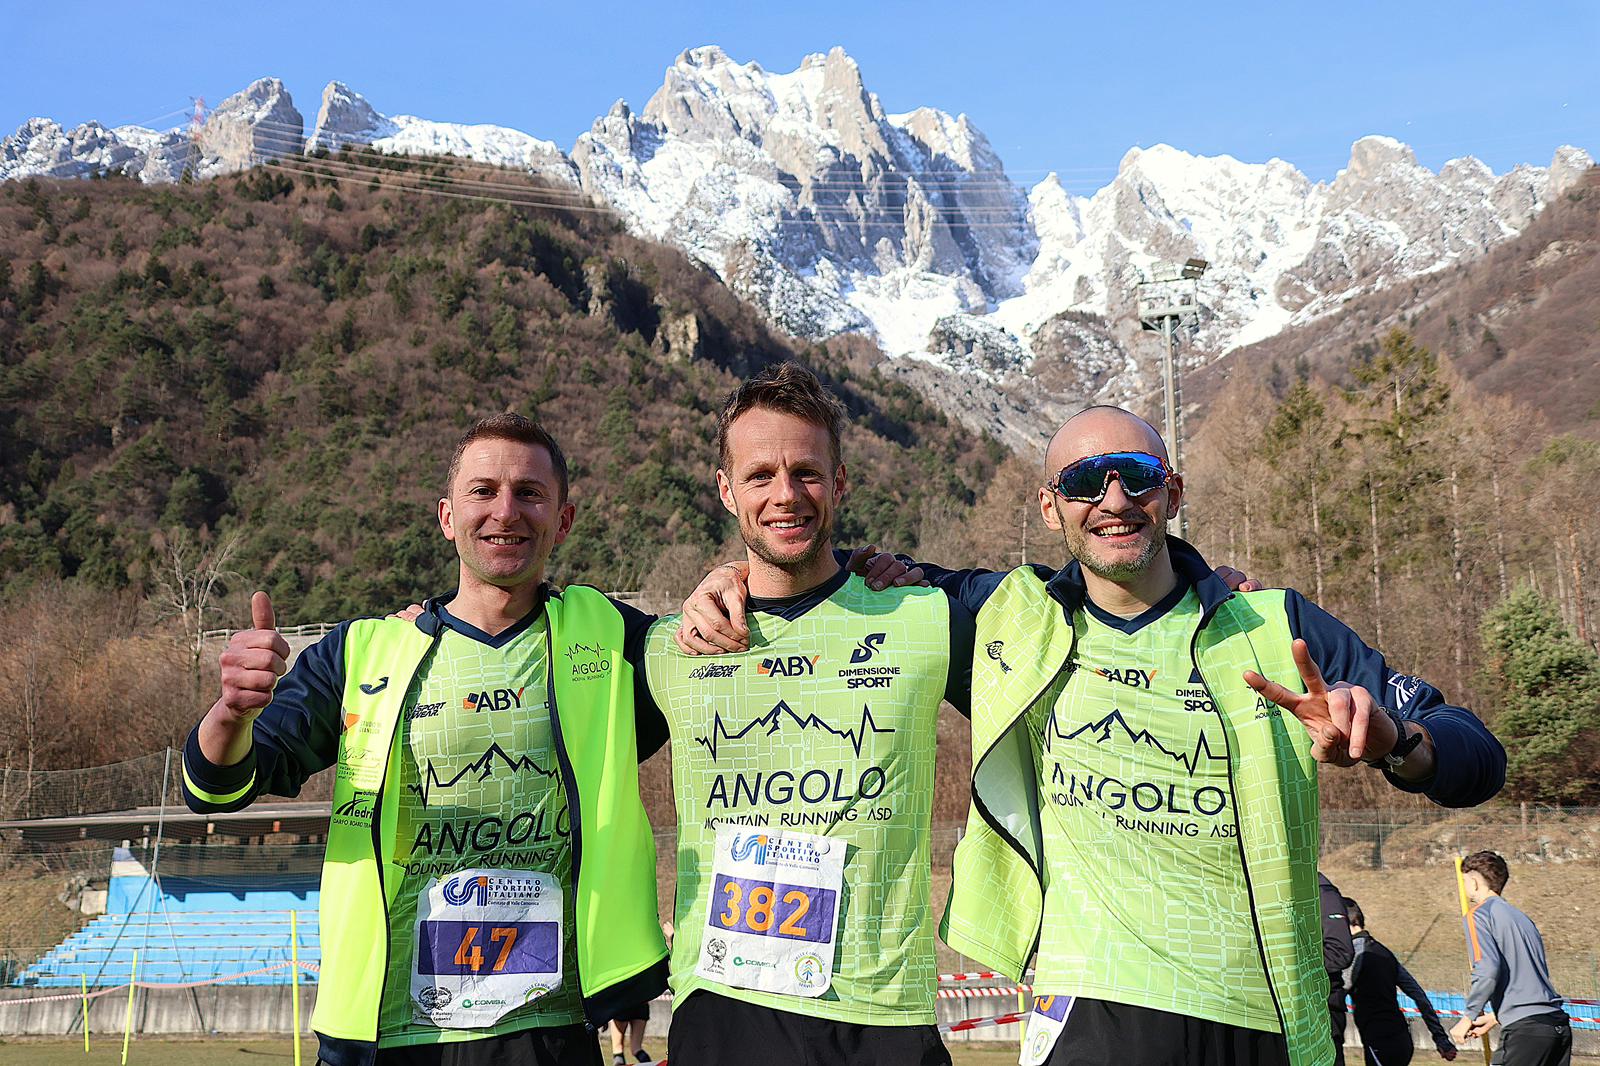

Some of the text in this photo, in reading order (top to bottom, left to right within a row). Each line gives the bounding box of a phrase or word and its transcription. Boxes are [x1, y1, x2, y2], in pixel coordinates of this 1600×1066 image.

[769, 655, 820, 677] ABY
[838, 667, 901, 677] DIMENSIONE
[847, 677, 894, 689] SPORT
[1108, 668, 1158, 689] ABY
[475, 687, 525, 712] ABY
[706, 767, 886, 808] ANGOLO
[1052, 763, 1227, 815] ANGOLO
[780, 808, 858, 827] RUNNING
[867, 807, 893, 821] ASD
[1115, 814, 1199, 837] RUNNING
[767, 845, 820, 857] SPORTIVO
[769, 837, 813, 849] CENTR
[479, 847, 555, 868] RUNNING
[720, 881, 810, 937] 382
[454, 927, 518, 971] 47
